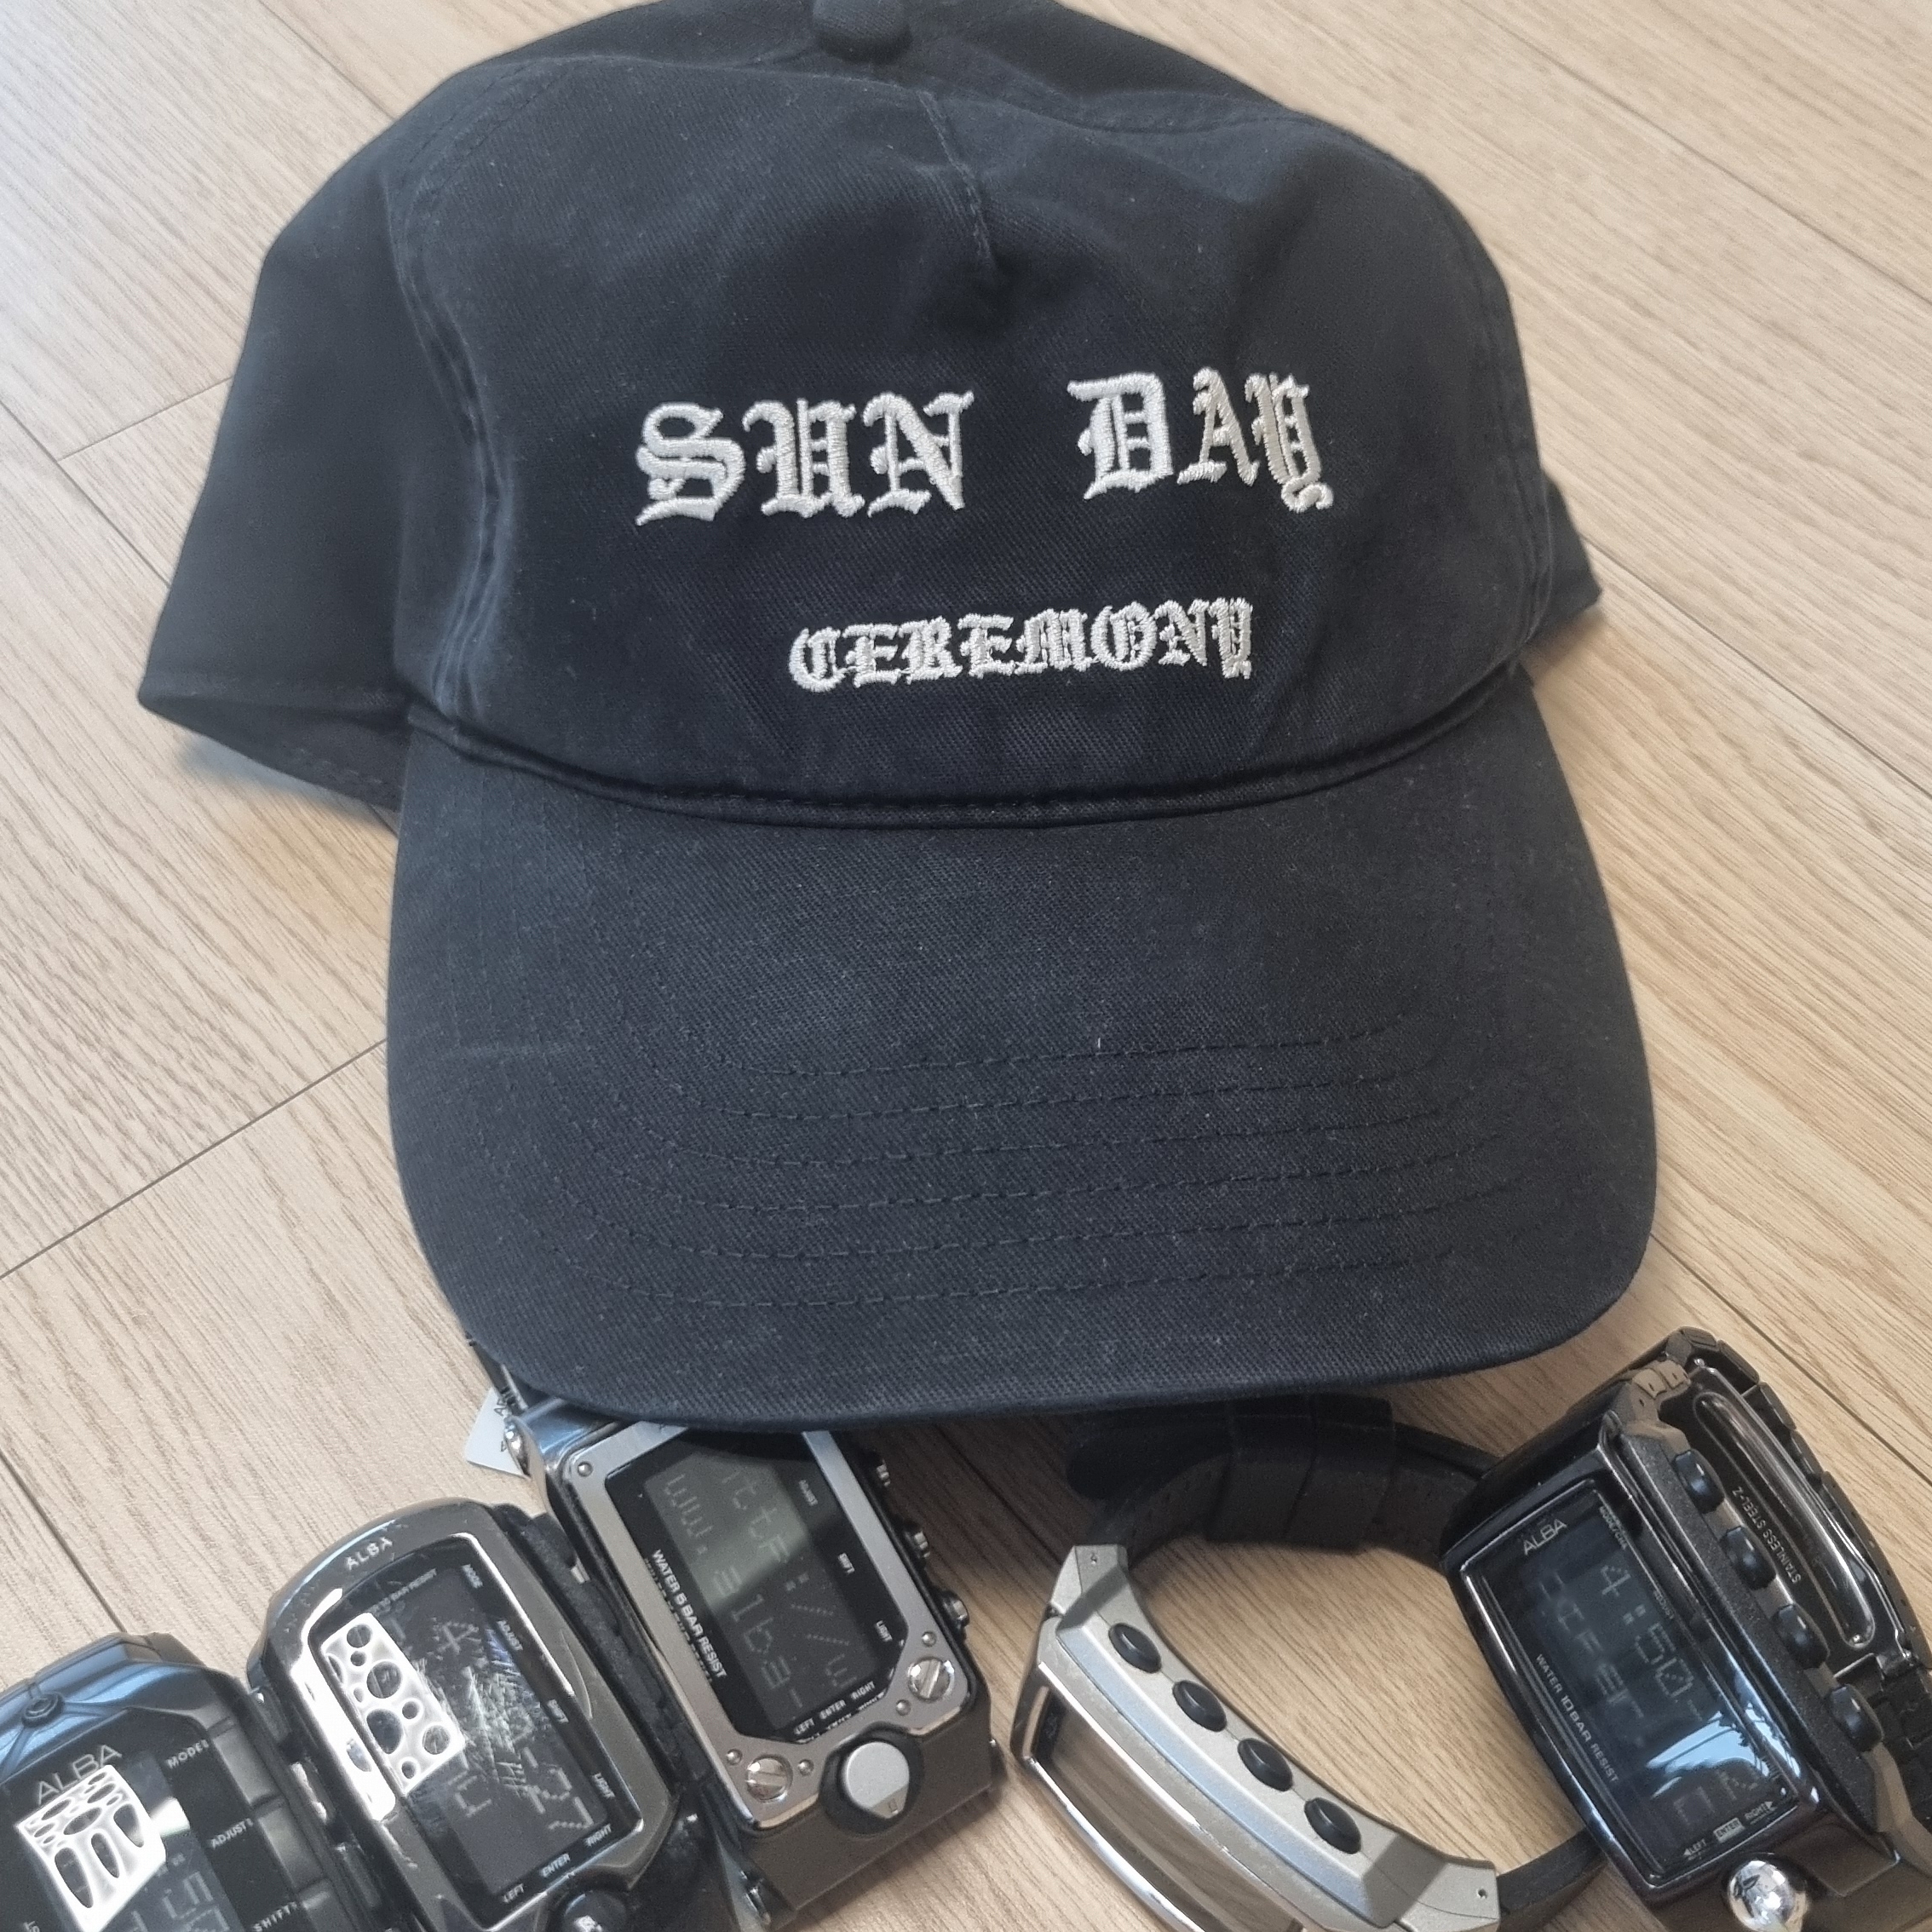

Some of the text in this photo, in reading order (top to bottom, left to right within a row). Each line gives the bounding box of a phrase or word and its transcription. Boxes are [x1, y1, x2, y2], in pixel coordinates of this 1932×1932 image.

[636, 368, 1333, 526] SUN DAY
[789, 598, 1252, 692] CEREMONY
[345, 1536, 393, 1571] ALBA
[1523, 1518, 1567, 1555] ALBA
[1763, 1529, 1801, 1584] STAINLESS
[653, 1550, 681, 1593] WATER
[681, 1605, 704, 1636] BAR
[699, 1636, 727, 1678] RESIST
[875, 1620, 893, 1642] LIGHT
[497, 1619, 524, 1652] ADJUST
[795, 1681, 876, 1735] LEFT ENTER RIGHT
[1536, 1653, 1563, 1693] WATER
[1590, 1743, 1619, 1783] RESIST
[166, 1742, 204, 1768] MODE
[37, 1744, 122, 1805] ALBA
[592, 1772, 616, 1798] LIGHT
[211, 1820, 247, 1849] ADJUST
[1685, 1837, 1707, 1856] LEFT
[1716, 1819, 1741, 1840] ENTER
[503, 1823, 612, 1904] LEFT ENTER RIGHT
[252, 1902, 293, 1932] SHIFT
